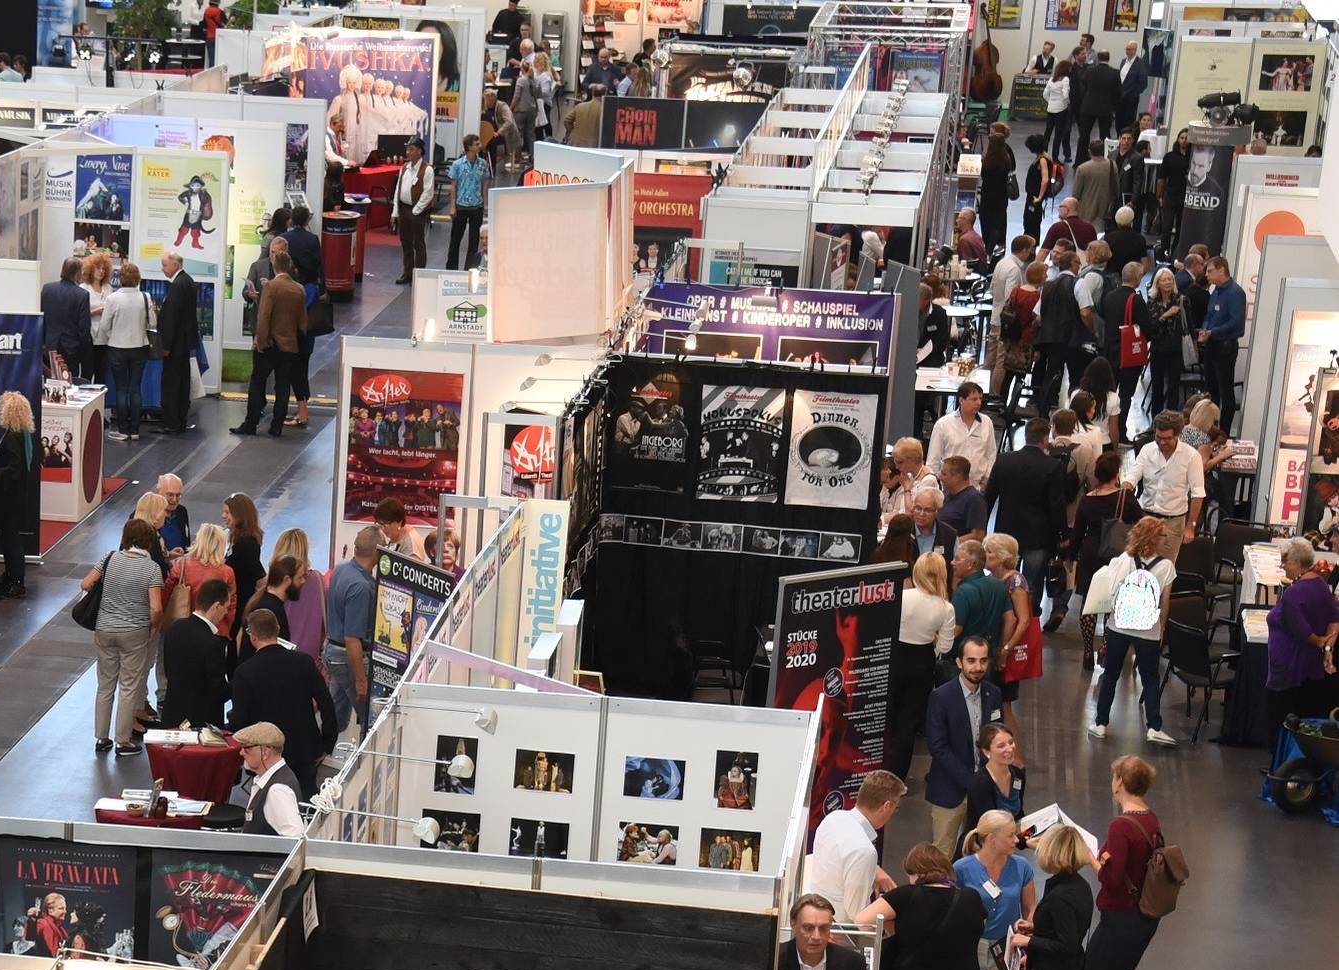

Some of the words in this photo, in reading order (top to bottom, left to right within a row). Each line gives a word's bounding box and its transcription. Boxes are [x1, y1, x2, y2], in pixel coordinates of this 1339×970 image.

[344, 17, 366, 28] WORLD
[368, 18, 399, 29] PERCUSSION
[310, 42, 324, 51] Die
[310, 50, 425, 72] IVUSHKA
[616, 109, 657, 122] CHOIR
[615, 124, 656, 145] MAN
[147, 170, 170, 178] KATER
[46, 180, 72, 188] MUSIK
[46, 187, 73, 197] BÜHNE
[640, 202, 694, 217] ORCHESTRA
[759, 269, 770, 277] YOU
[771, 269, 782, 278] CAN
[686, 295, 714, 308] OPER
[793, 300, 859, 316] SCHAUSPIEL
[743, 312, 810, 328] KINDEROPER
[826, 317, 883, 331] INKLUSION
[0, 332, 22, 351] art
[812, 394, 860, 405] Filmtheater
[703, 406, 782, 426] HOKUSPOKUS
[642, 435, 683, 449] INGEBORG
[368, 448, 381, 456] Wer
[382, 448, 400, 457] lacht,
[416, 450, 437, 459] länger.
[414, 504, 438, 512] DISTEL
[402, 565, 451, 596] CONCERTS
[792, 580, 896, 614] theaterlust.
[787, 630, 818, 643] STÜCKE
[786, 640, 818, 656] 2019
[786, 653, 817, 669] 2020
[17, 860, 38, 880] LA
[43, 863, 119, 886] TRAVIATA
[175, 881, 259, 902] Fledermaus
